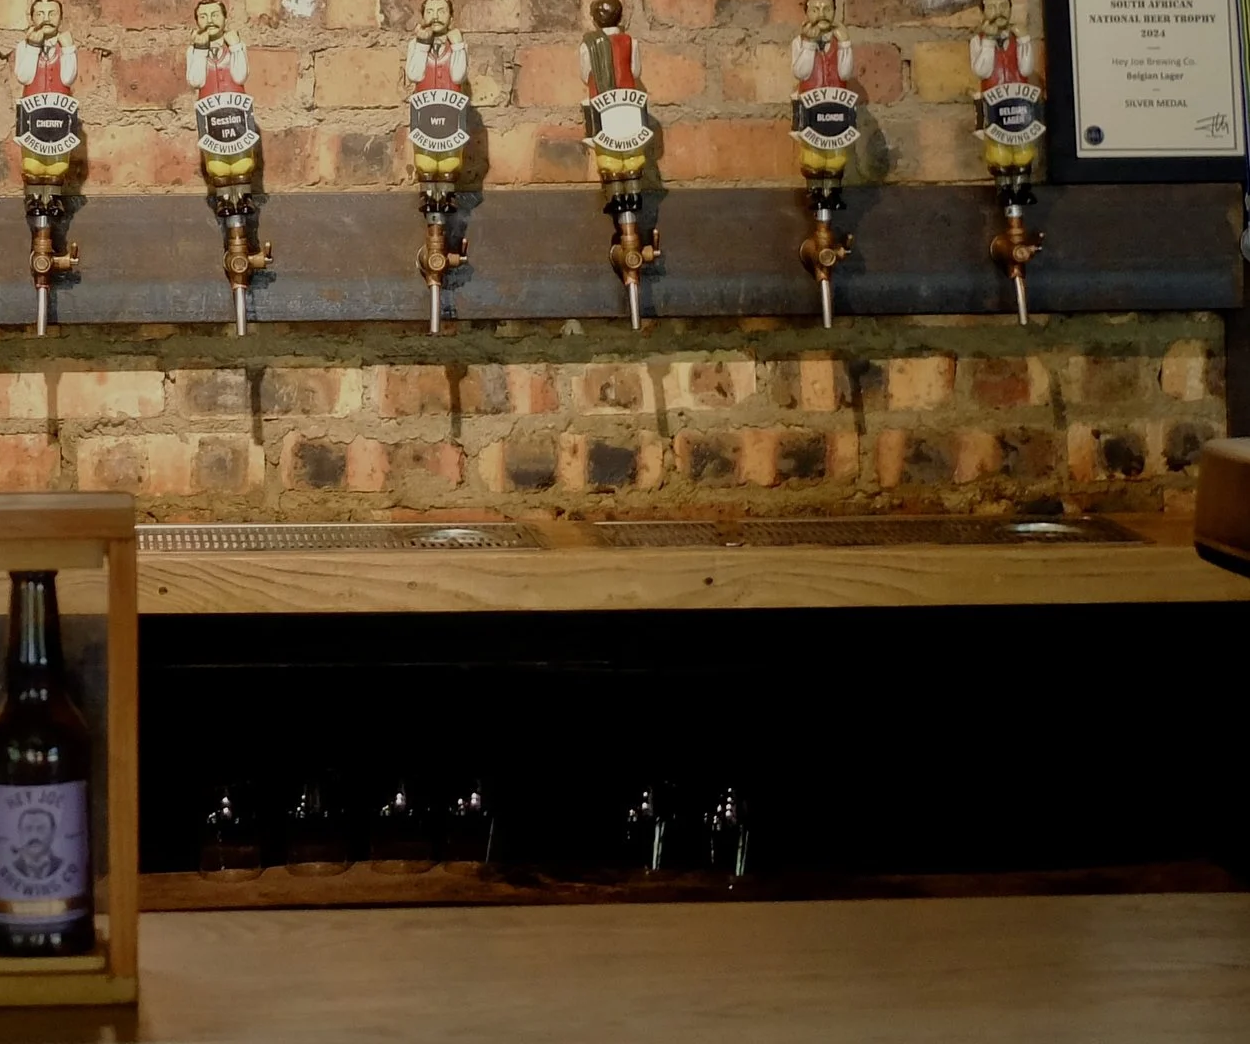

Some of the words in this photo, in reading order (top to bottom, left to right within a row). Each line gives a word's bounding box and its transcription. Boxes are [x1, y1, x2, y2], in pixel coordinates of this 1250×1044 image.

[1110, 0, 1145, 8] SOUTH
[1148, 0, 1193, 8] AFRICAN
[1089, 14, 1141, 23] NATIONAL
[1143, 14, 1171, 23] BEER
[1174, 14, 1216, 23] TROPHY
[1141, 29, 1166, 38] 2024
[1112, 58, 1128, 67] Hey
[1130, 58, 1145, 66] Joe
[1147, 57, 1181, 67] Brewing
[1126, 71, 1158, 81] Belgian
[1160, 72, 1184, 81] Lager
[412, 90, 437, 107] HEY
[442, 91, 466, 109] JOE
[594, 91, 617, 110] HEY
[622, 90, 645, 106] JOE
[804, 89, 828, 106] HEY
[832, 89, 856, 107] JOE
[987, 85, 1010, 103] HEY
[1015, 84, 1038, 101] JOE
[24, 94, 48, 111] HEY
[53, 94, 77, 112] JOE
[198, 94, 221, 113] HEY
[227, 94, 251, 109] JOE
[1125, 99, 1154, 108] SILVER
[1156, 99, 1188, 108] MEDAL
[211, 115, 241, 126] Session
[221, 128, 236, 138] IPA
[412, 131, 453, 150] BREWING
[453, 132, 465, 144] CO
[598, 132, 638, 150] BREWING
[638, 128, 649, 141] CO
[804, 130, 844, 148] BREWING
[844, 129, 856, 141] CO
[990, 127, 1030, 143] BREWING
[1030, 123, 1042, 136] CO
[24, 136, 63, 154] BREWING
[64, 136, 76, 148] CO
[203, 137, 243, 153] BREWING
[243, 132, 255, 145] CO
[6, 791, 32, 809] HEY
[38, 790, 65, 808] JOE
